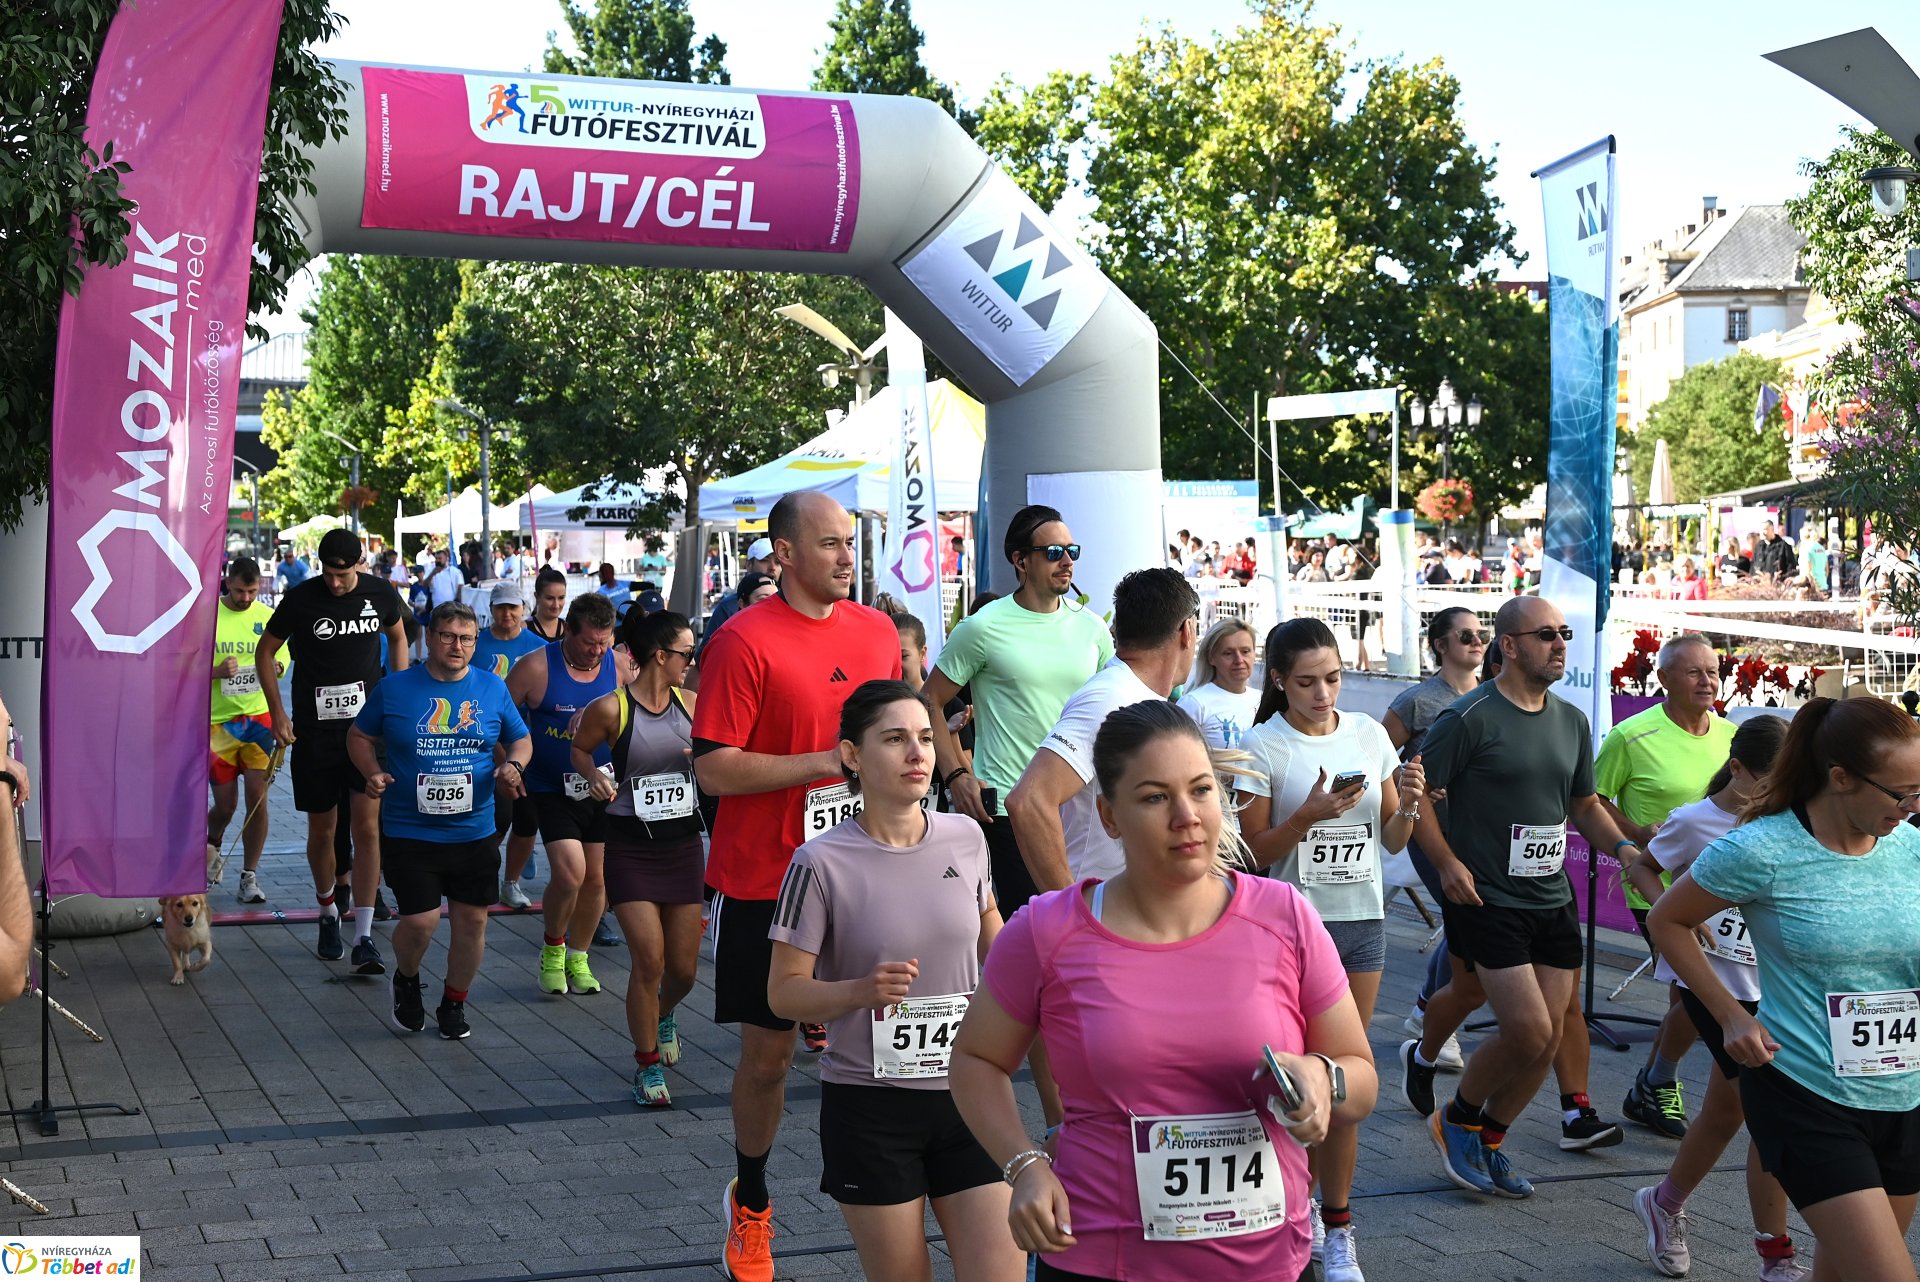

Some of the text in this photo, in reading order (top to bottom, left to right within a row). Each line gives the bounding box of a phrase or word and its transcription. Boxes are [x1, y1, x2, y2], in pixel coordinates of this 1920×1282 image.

[568, 97, 754, 121] WITTUR-NYÍREGYHÁZI
[531, 113, 758, 148] FUTÓFESZTIVÁL
[380, 93, 392, 192] www.mozaikmed.hu
[830, 104, 847, 245] www.nyiregyhazifutofesztival.hu
[458, 164, 770, 232] RAJT/CÉL
[182, 232, 207, 311] med
[961, 279, 1013, 334] WITTUR
[112, 220, 180, 508] MOZAIK
[200, 320, 224, 515] Az orvosi futóközösség
[338, 618, 380, 635] JAKO
[228, 674, 255, 686] 5056
[325, 695, 358, 709] 5138
[416, 738, 485, 749] SISTER CITY
[416, 748, 450, 757] RUNNING
[426, 786, 465, 801] 5036
[644, 786, 685, 806] 5179
[813, 800, 863, 830] 5186
[1312, 842, 1366, 863] 5177
[1523, 839, 1563, 859] 5042
[900, 1008, 953, 1019] FUTÓFESZTIVÁL
[1851, 1017, 1917, 1047] 5144
[1171, 1135, 1247, 1149] FUTÓFESZTIVÁL
[1184, 1127, 1246, 1138] WITTUR-NYÍREGYHÁZI
[1163, 1151, 1264, 1197] 5114
